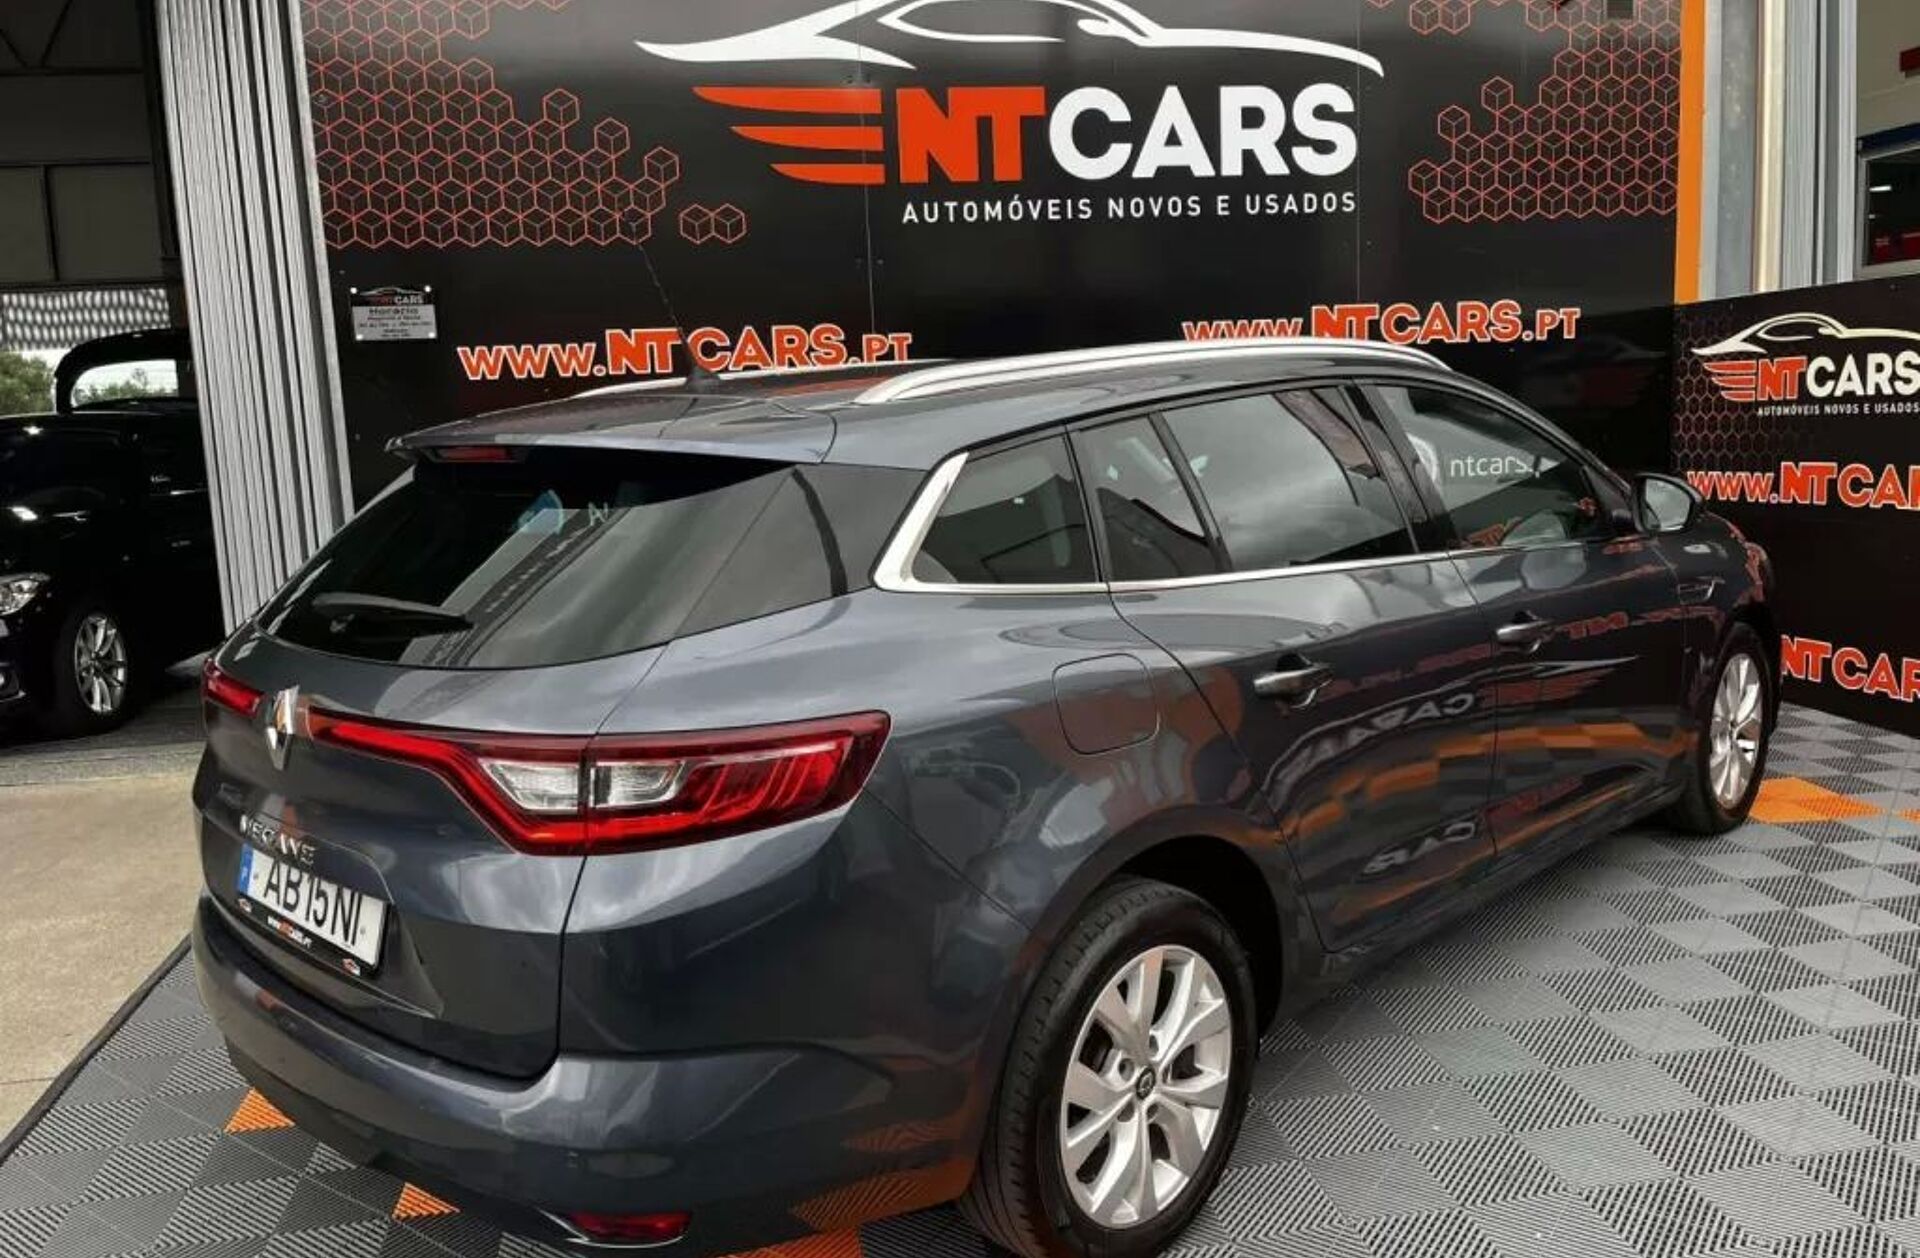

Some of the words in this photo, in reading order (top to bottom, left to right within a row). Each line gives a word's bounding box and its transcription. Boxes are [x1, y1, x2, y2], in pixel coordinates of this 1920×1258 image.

[902, 194, 1093, 224] AUTOMÓVEIS
[1108, 196, 1201, 218] NOVOS
[1217, 195, 1230, 216] E
[1246, 191, 1356, 215] USADOS
[1824, 403, 1859, 415] NOVOS
[1863, 403, 1871, 414] E
[1874, 402, 1920, 413] USADOS
